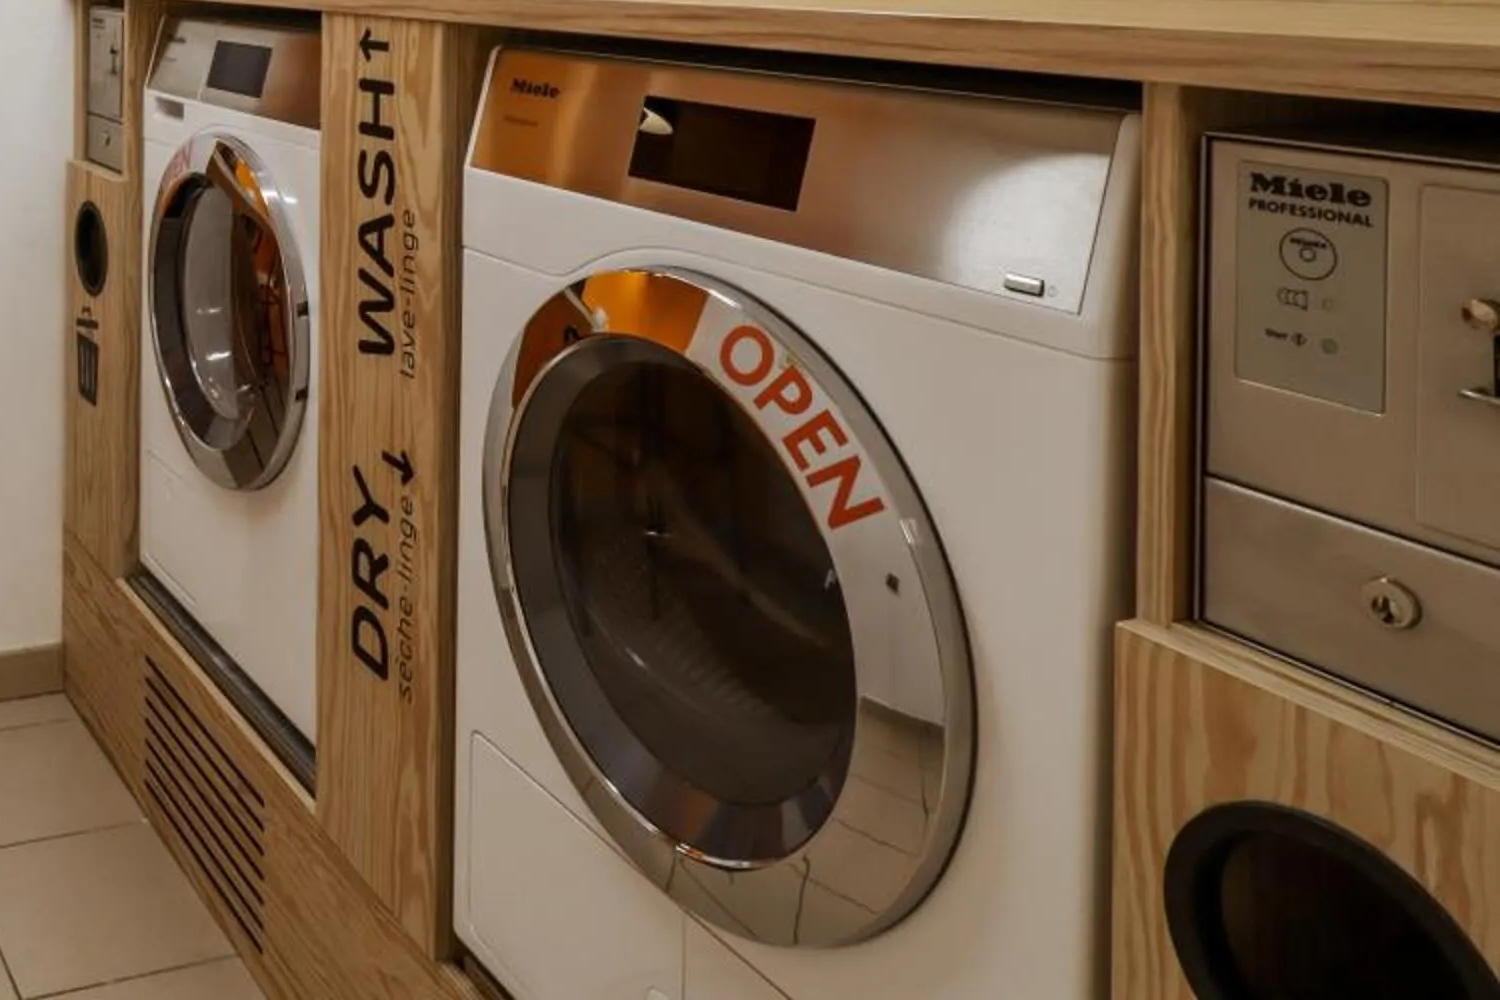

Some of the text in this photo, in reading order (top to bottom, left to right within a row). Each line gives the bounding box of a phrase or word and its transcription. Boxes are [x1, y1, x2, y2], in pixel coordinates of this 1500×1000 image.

[510, 77, 561, 100] Miele
[358, 77, 396, 357] WASH
[1249, 198, 1374, 229] PROFESSIONAL
[1250, 172, 1372, 207] Miele
[400, 208, 419, 380] lave-linge
[719, 324, 886, 530] OPEN
[352, 464, 390, 682] DRY
[396, 495, 418, 705] sèche-linge
